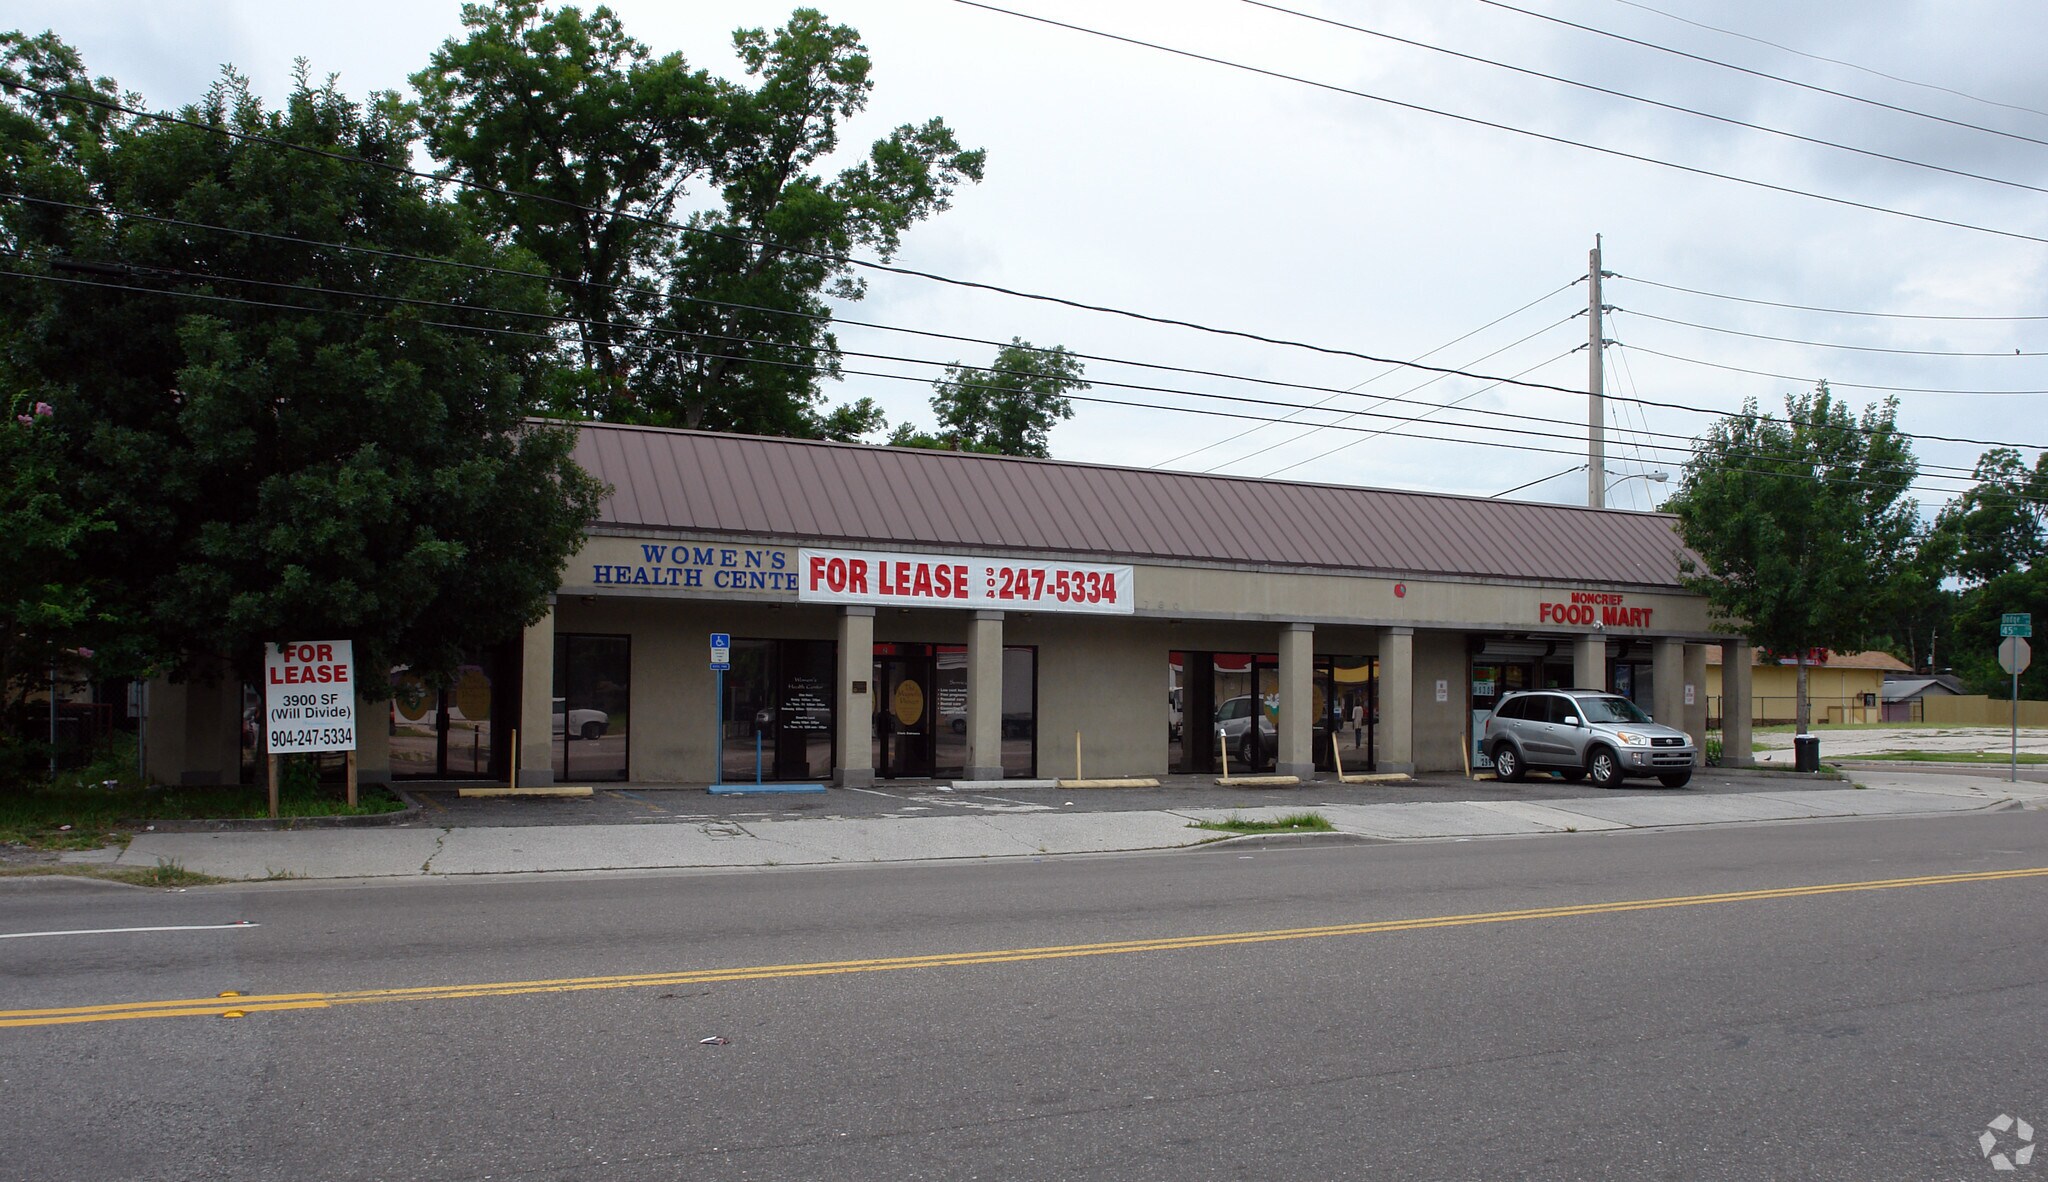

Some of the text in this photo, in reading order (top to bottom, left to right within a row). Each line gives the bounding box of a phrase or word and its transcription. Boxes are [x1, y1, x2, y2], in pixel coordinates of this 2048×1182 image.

[641, 544, 786, 569] WOMEN'S
[593, 564, 703, 587] HEALTH
[810, 557, 868, 594] FOR
[879, 561, 969, 599] LEASE
[999, 567, 1117, 604] 247-5334
[1571, 592, 1624, 606] MONCRIEF
[1540, 603, 1653, 628] FOOD MART
[284, 644, 333, 663] FOR
[270, 665, 348, 684] LEASE
[283, 694, 338, 707] 3900 SF
[271, 705, 351, 723] (Will Divide)
[271, 728, 352, 747] 904-247-5334
